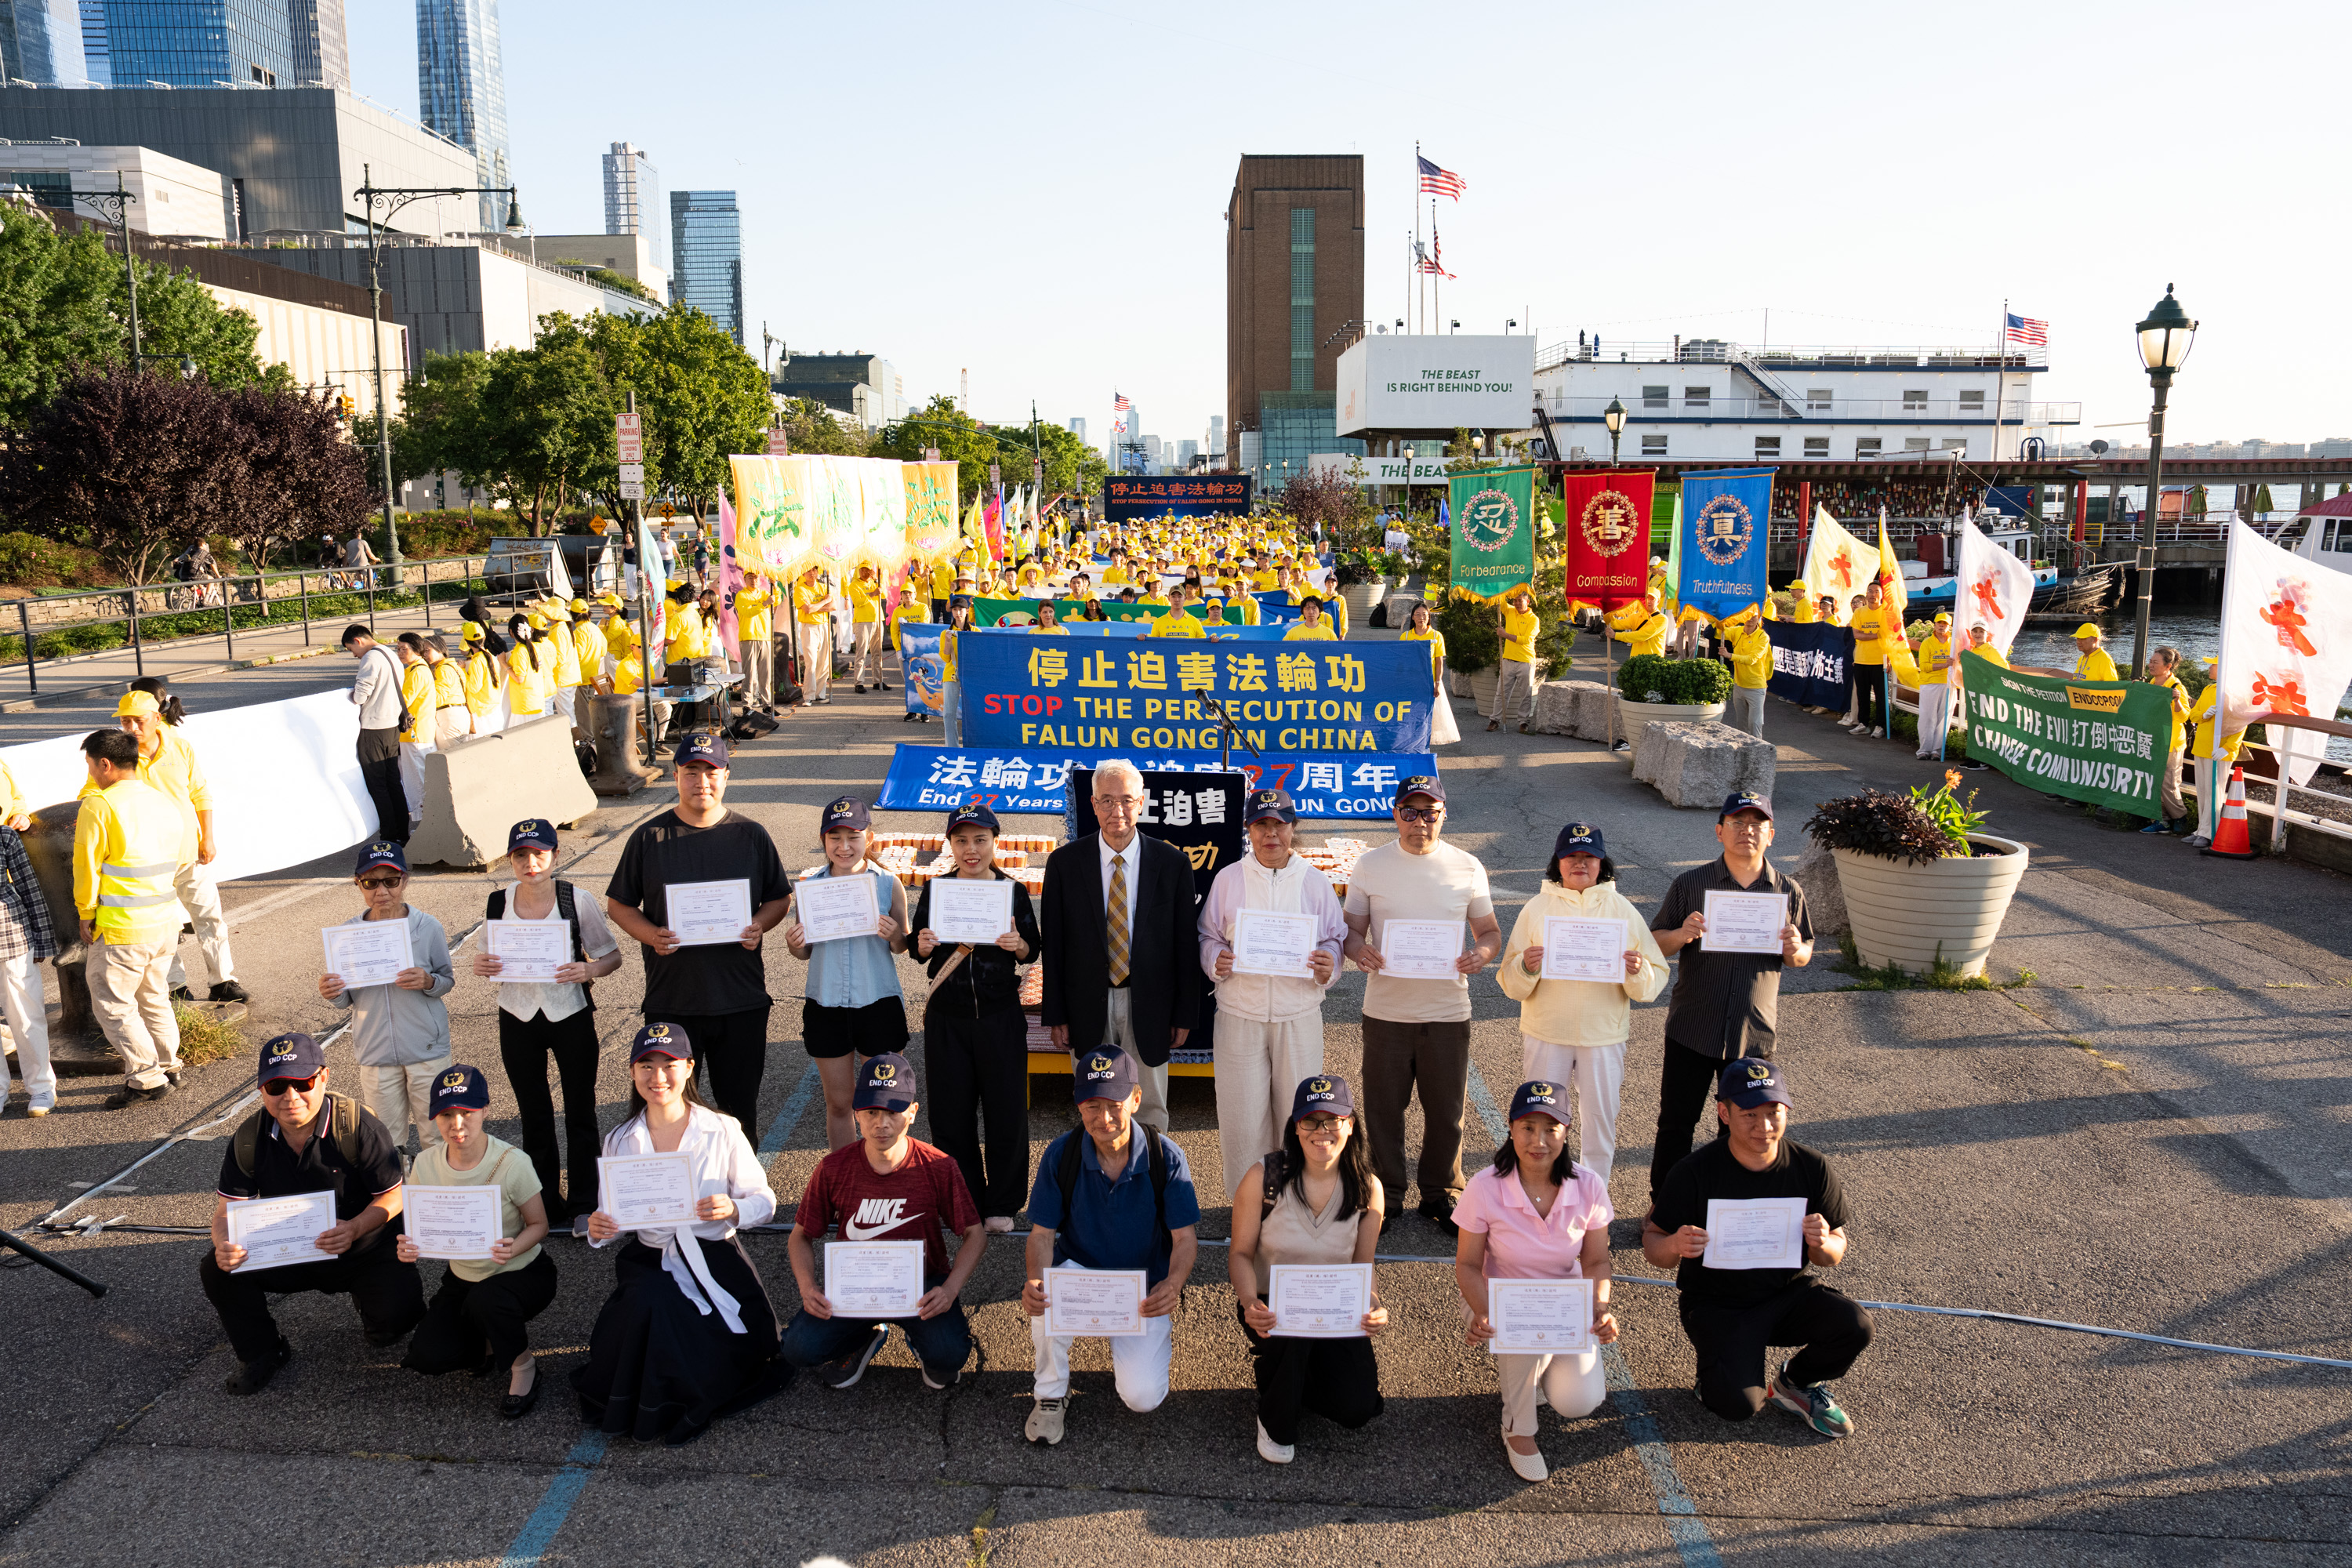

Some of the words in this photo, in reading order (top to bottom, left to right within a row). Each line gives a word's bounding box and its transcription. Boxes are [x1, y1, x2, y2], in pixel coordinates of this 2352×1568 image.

[1421, 370, 1443, 379] THE
[1446, 370, 1481, 379] BEAST
[1387, 383, 1396, 392] IS
[1400, 383, 1435, 392] RIGHT
[1438, 383, 1482, 392] BEHIND
[1485, 383, 1512, 393] YOU!
[625, 417, 632, 426] NO
[620, 427, 638, 436] PARKING
[1381, 465, 1408, 477] THE
[1414, 465, 1446, 477] BEA
[1110, 482, 1244, 495] 停止迫害法輪功
[906, 477, 952, 528] 法
[1591, 504, 1630, 539] 善
[1707, 510, 1742, 546] 真
[1461, 564, 1525, 577] Forbearance
[1577, 573, 1637, 588] Compassion
[1693, 579, 1752, 596] Truthfulness
[1028, 647, 1366, 692] 停止迫害法輪功
[2001, 677, 2021, 692] SIGN
[2020, 684, 2037, 698] THE
[2035, 689, 2067, 702] PETITION
[984, 694, 1063, 717] STOP
[1073, 697, 1132, 719] THE
[1374, 701, 1412, 722] OF
[1968, 690, 2009, 722] END
[2013, 703, 2042, 736] THE
[1022, 724, 1119, 748] FALUN
[1131, 728, 1218, 750] GONG
[1232, 729, 1265, 750] IN
[1279, 728, 1377, 750] CHINA
[918, 789, 963, 806] End
[970, 794, 999, 806] 27
[644, 1037, 657, 1046] END
[268, 1055, 281, 1065] END
[1747, 1080, 1762, 1088] END
[439, 1087, 452, 1096] END
[1541, 1095, 1555, 1105] CCP
[855, 1199, 907, 1224] NIKE
